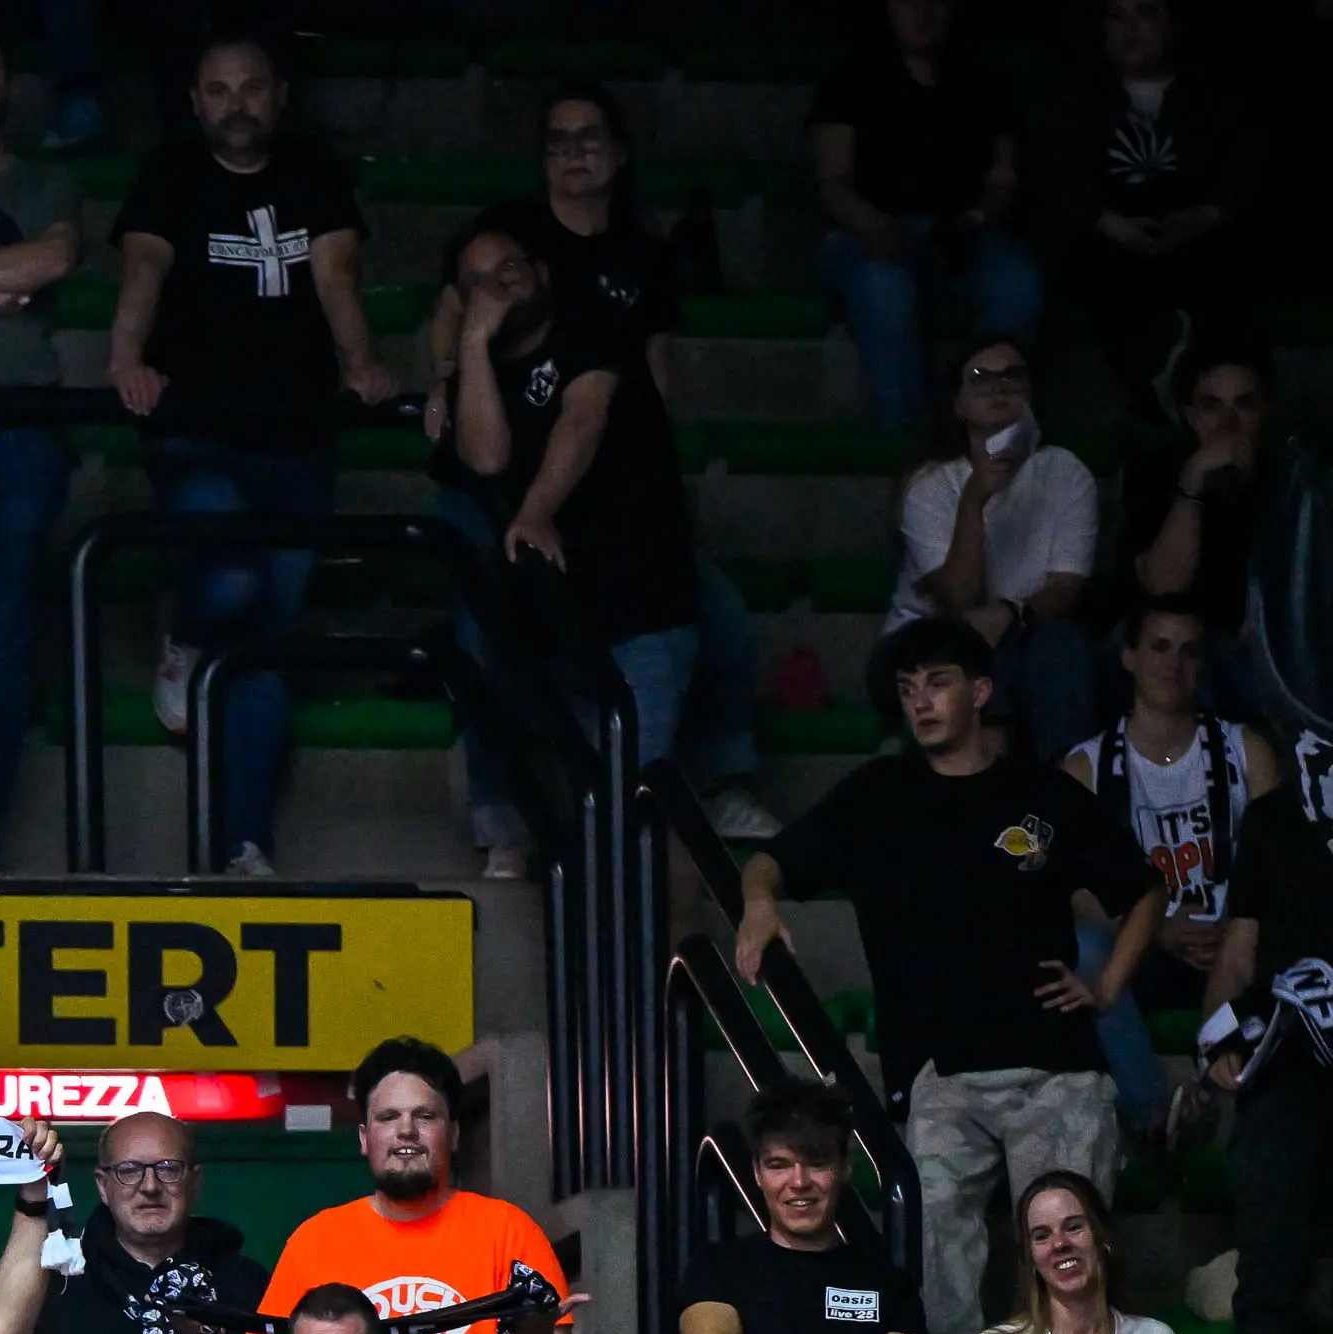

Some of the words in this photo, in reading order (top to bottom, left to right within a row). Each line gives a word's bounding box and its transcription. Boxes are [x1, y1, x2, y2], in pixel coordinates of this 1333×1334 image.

[831, 1293, 874, 1305] oasis
[829, 1309, 853, 1319] live
[853, 1309, 875, 1320] '25
